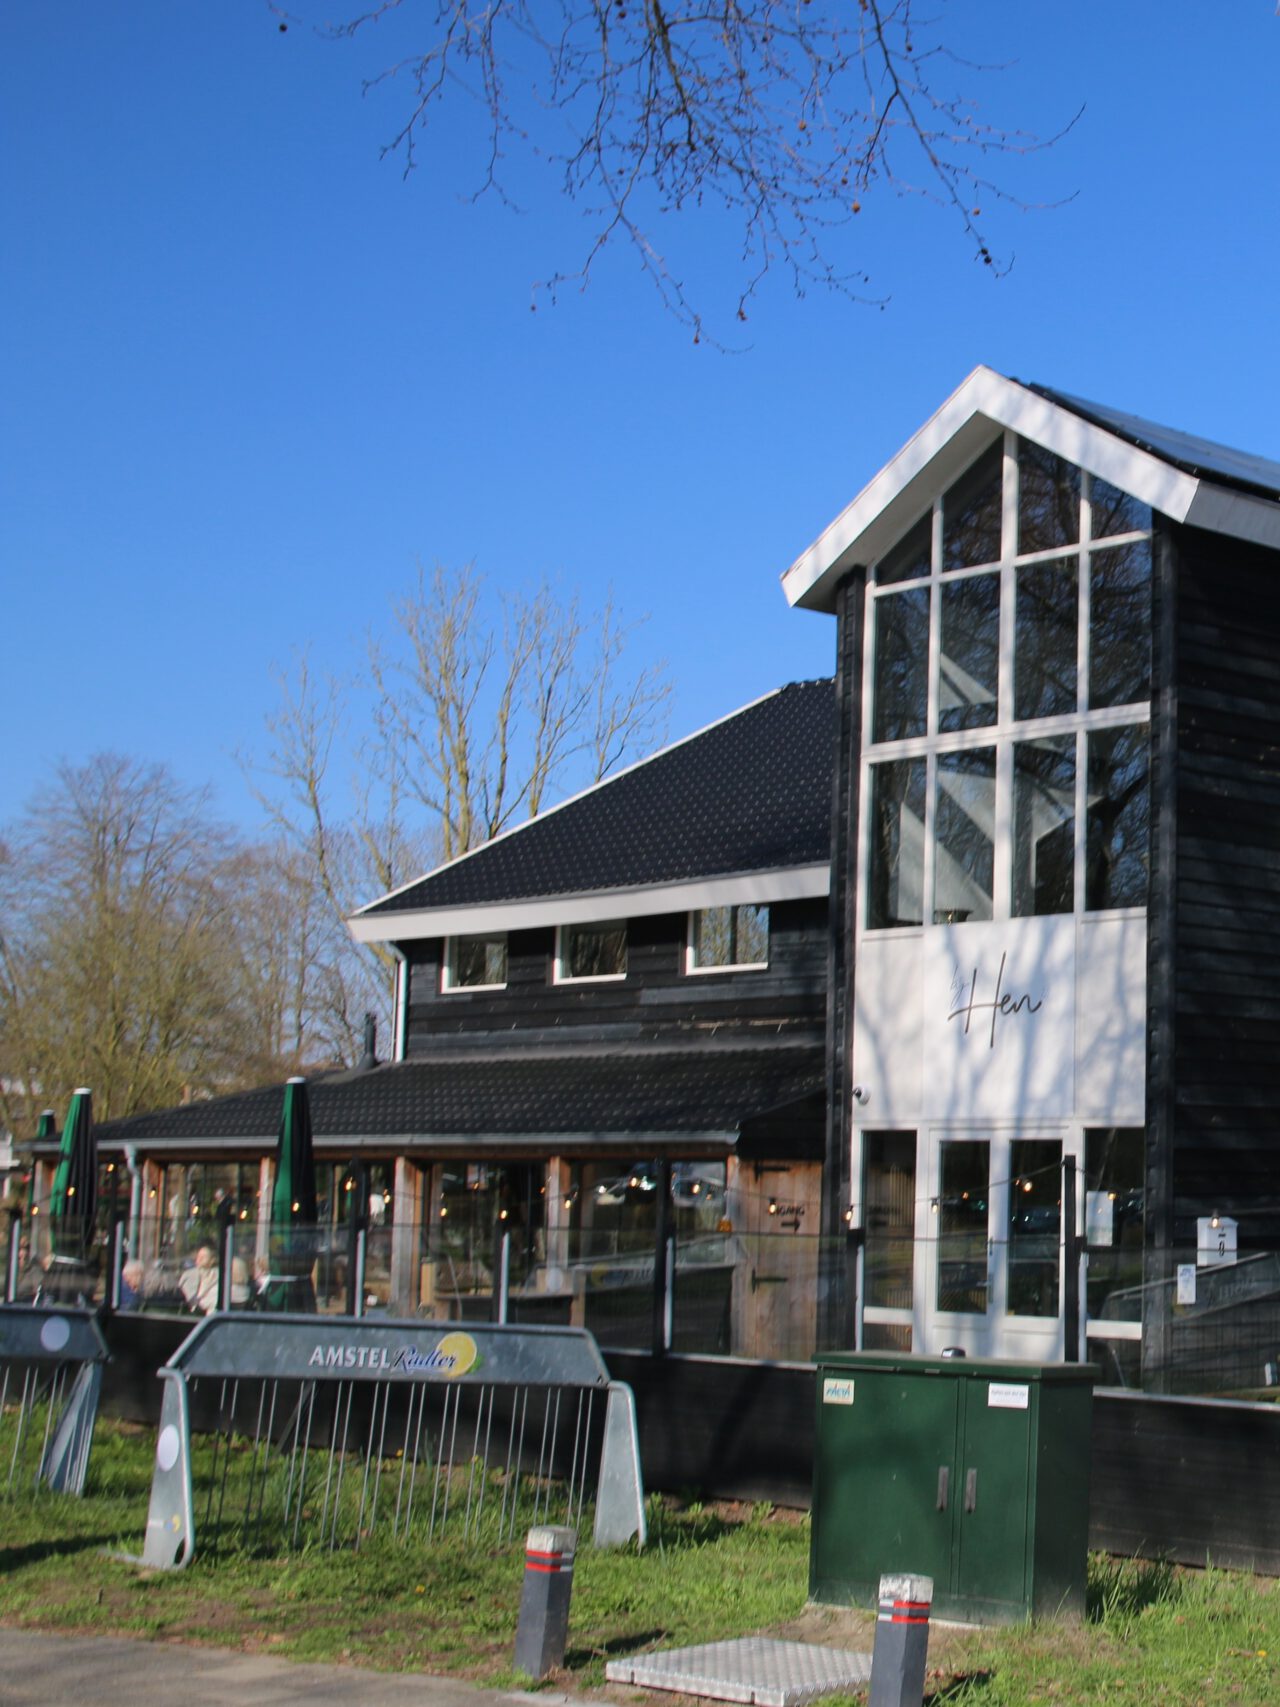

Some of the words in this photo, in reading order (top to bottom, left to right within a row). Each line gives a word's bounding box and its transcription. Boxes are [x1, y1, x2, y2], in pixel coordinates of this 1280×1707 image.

[948, 950, 1042, 1048] Hen
[308, 1344, 391, 1369] AMSTEL
[391, 1344, 456, 1374] Radler
